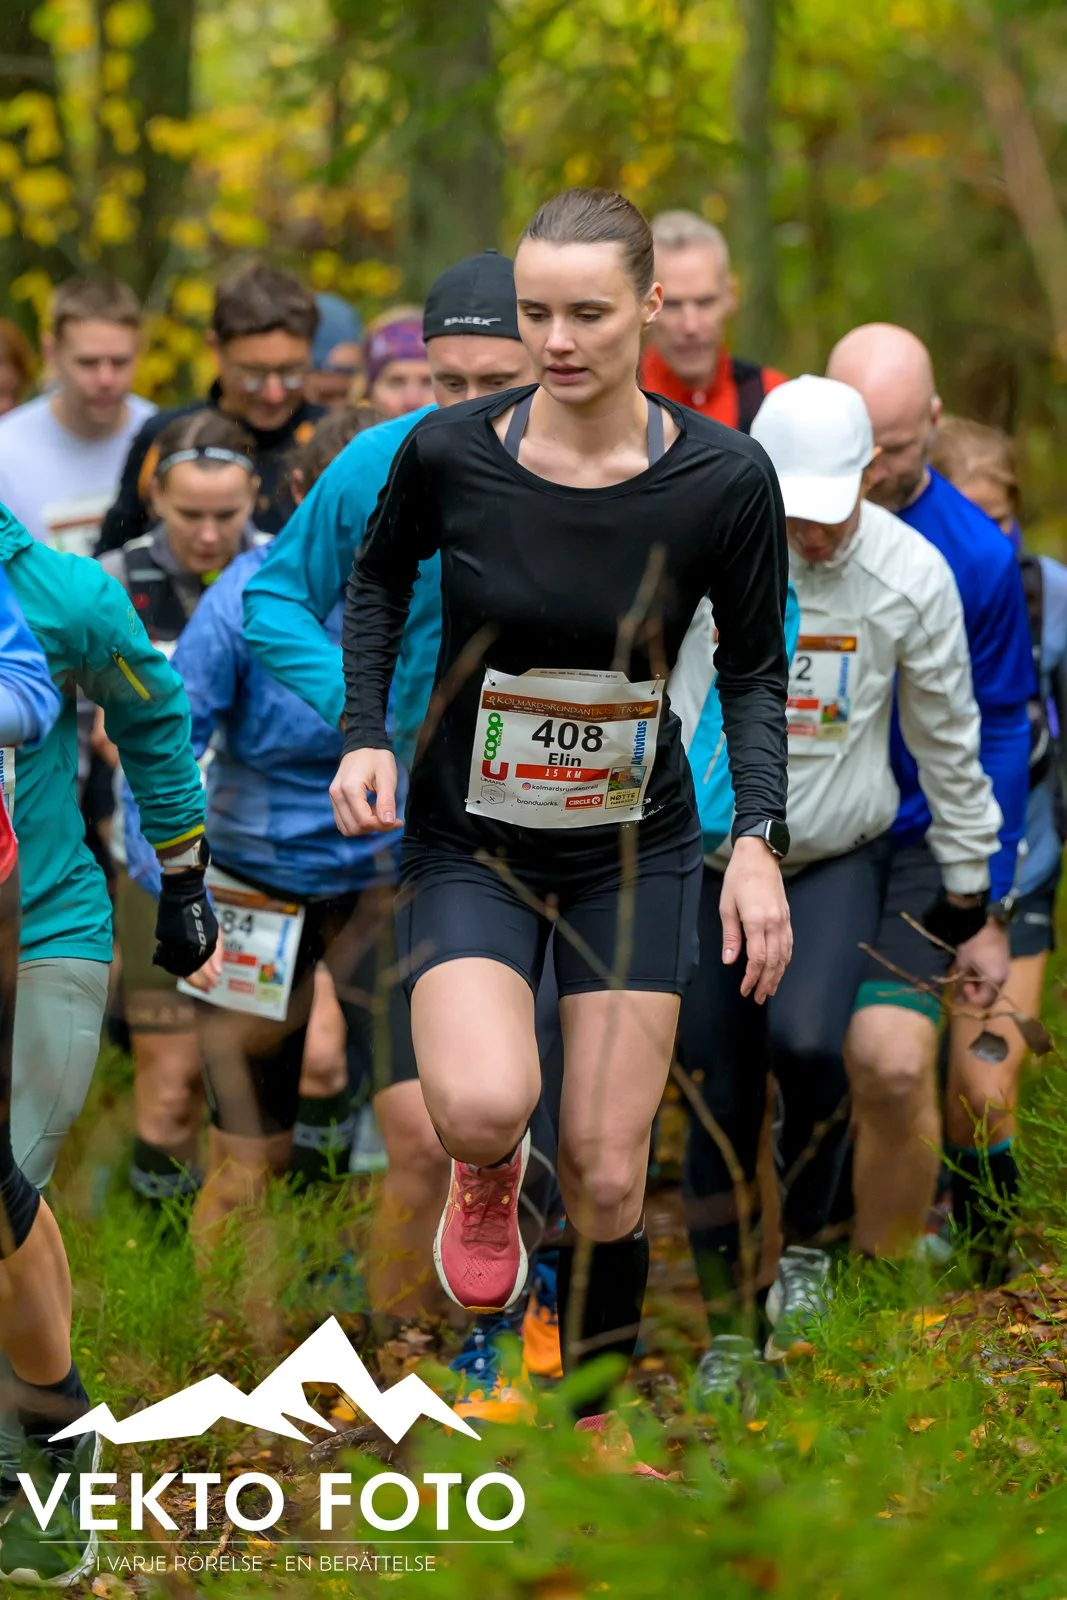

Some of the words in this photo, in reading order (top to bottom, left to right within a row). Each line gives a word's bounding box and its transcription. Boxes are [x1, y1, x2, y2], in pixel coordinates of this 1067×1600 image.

[444, 315, 501, 326] SPACEX
[484, 712, 504, 760] coop
[531, 719, 604, 752] 408
[631, 720, 647, 765] Aktivitus
[548, 752, 582, 767] Elin
[545, 769, 559, 777] 15
[566, 770, 582, 779] KM
[568, 798, 591, 806] CIRCLE
